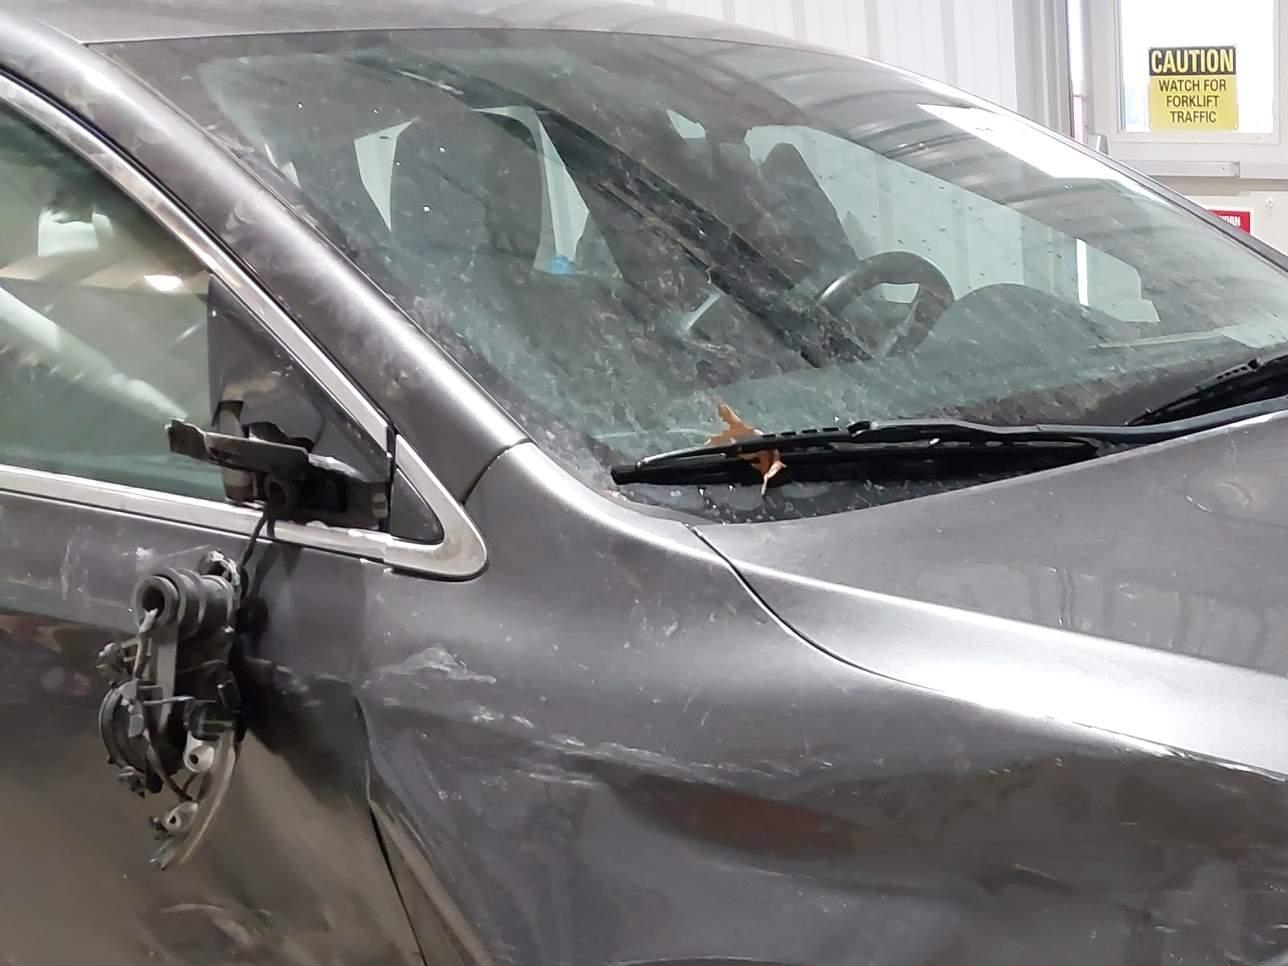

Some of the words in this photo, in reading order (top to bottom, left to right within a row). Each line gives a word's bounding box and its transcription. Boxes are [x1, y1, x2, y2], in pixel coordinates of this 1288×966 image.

[1151, 48, 1234, 73] CAUTION
[1159, 79, 1200, 92] WATCH
[1203, 79, 1226, 92] FOR
[1166, 95, 1220, 107] FORKLIFT
[1170, 111, 1217, 123] TRAFFIC
